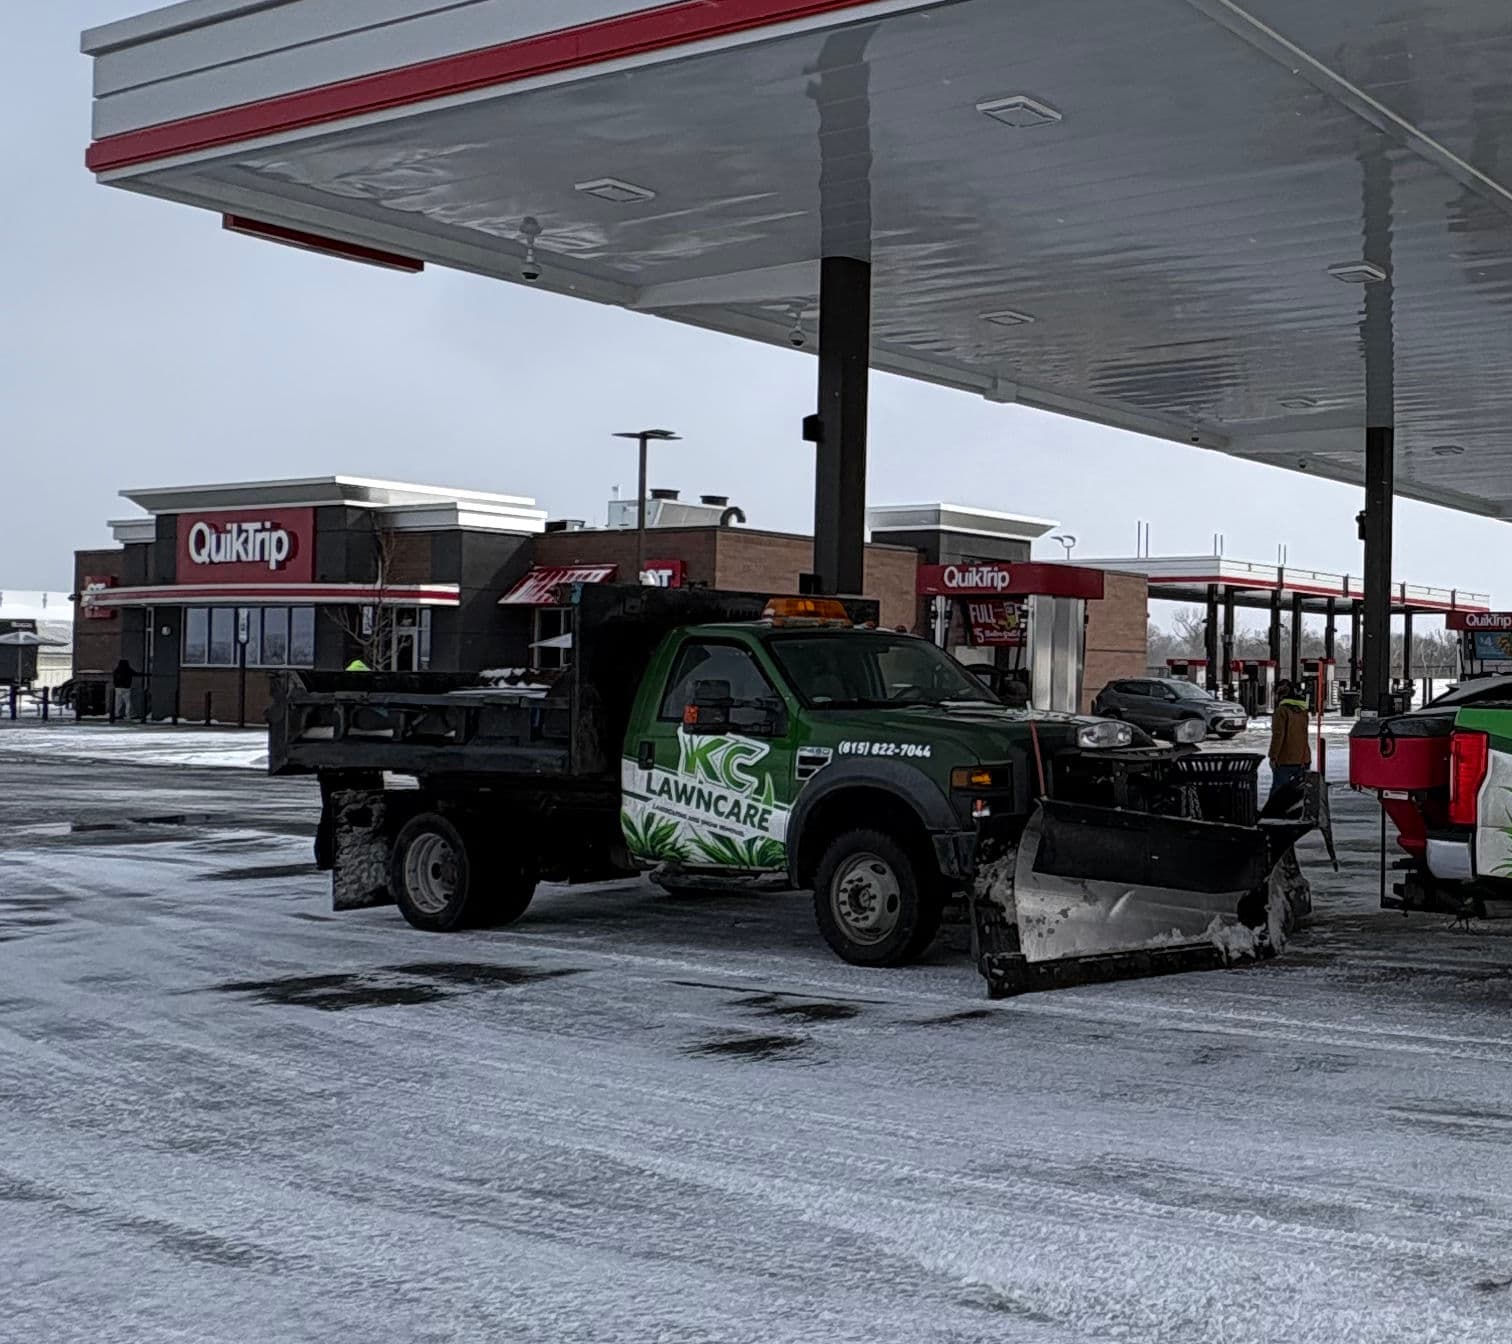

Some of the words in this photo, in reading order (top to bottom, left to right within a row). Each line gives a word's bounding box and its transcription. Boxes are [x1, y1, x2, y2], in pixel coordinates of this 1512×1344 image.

[188, 521, 289, 570] QuikTrip
[943, 566, 1010, 591] QuikTrip
[1465, 613, 1512, 628] QuikTrip
[680, 733, 766, 795] KC
[838, 741, 870, 755] (815)
[872, 742, 932, 758] 822-7044
[645, 771, 773, 833] LAWNCARE
